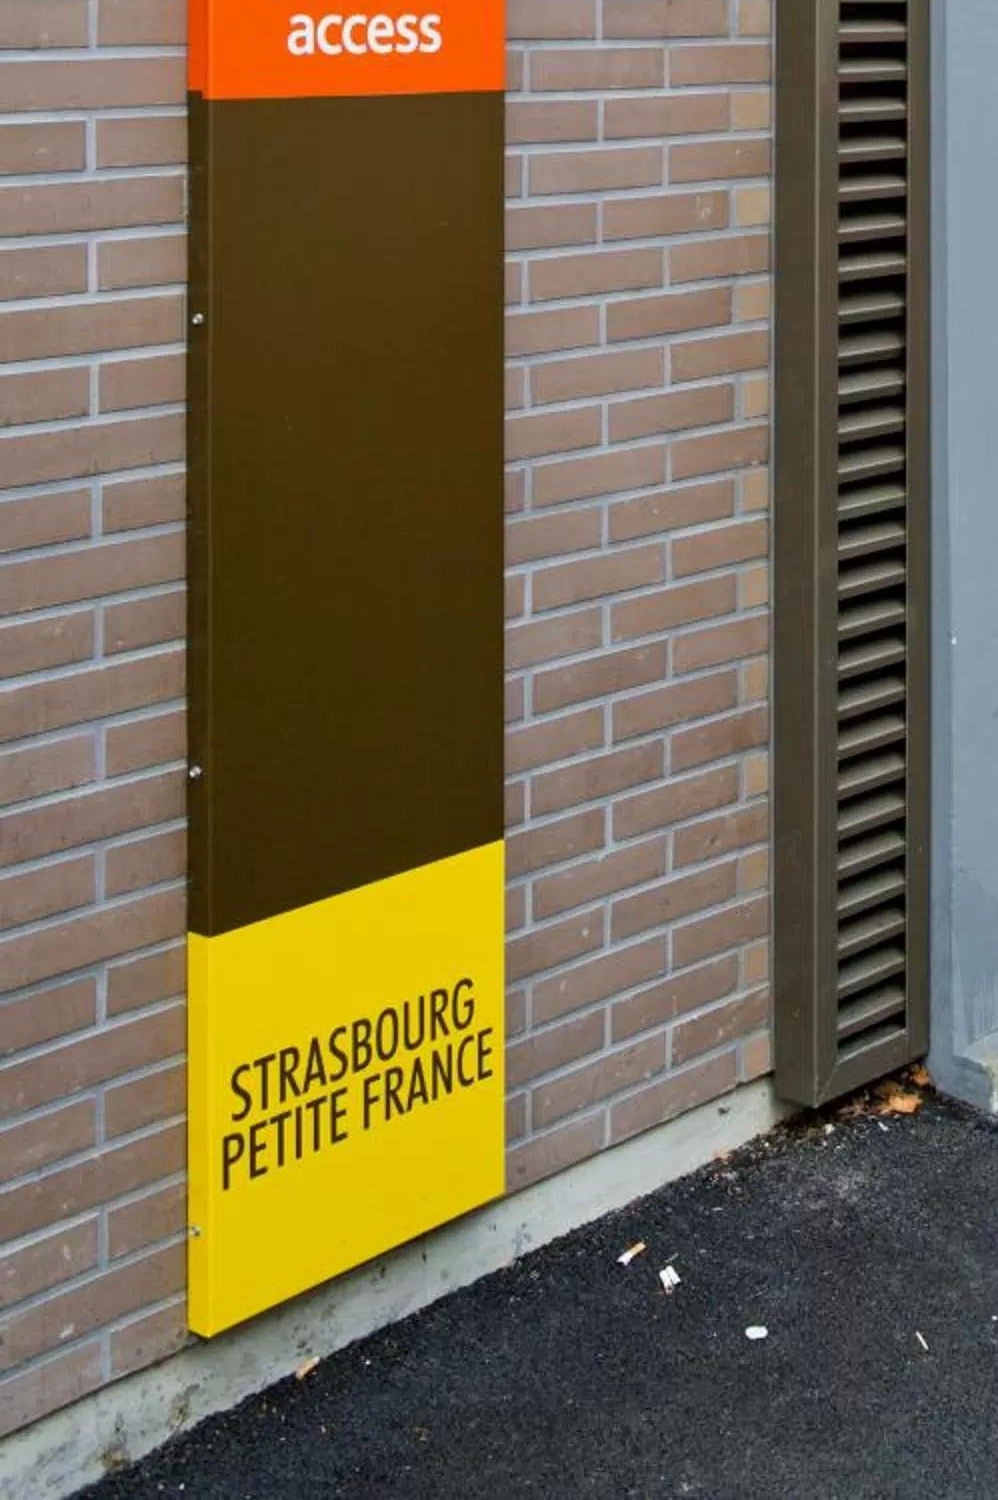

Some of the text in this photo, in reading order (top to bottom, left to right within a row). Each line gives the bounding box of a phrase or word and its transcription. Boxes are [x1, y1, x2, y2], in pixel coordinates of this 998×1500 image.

[286, 12, 443, 56] access
[221, 1026, 494, 1191] PETITE FRANCE
[230, 977, 475, 1122] STRASBOURG
